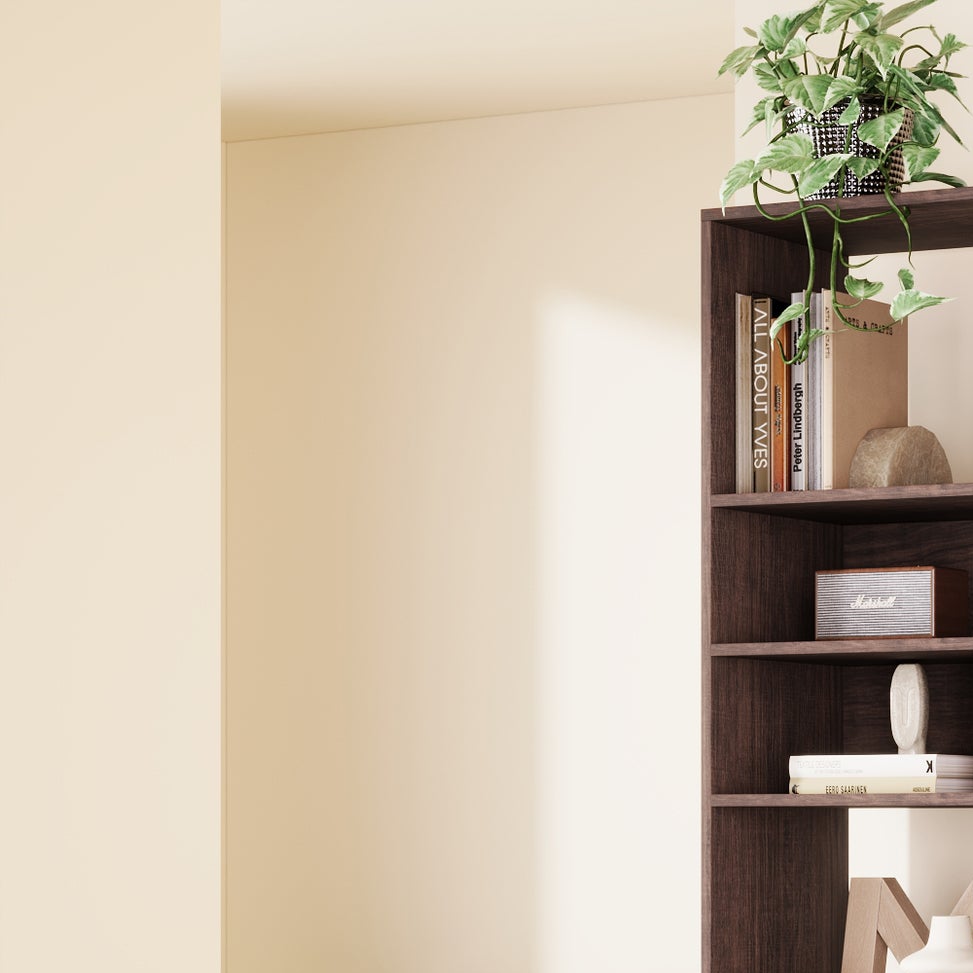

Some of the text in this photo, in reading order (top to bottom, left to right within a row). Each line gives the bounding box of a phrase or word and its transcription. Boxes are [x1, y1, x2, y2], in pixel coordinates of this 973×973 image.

[753, 307, 768, 469] ALL ABOUT YVES
[793, 382, 803, 473] Peter Lindbergh
